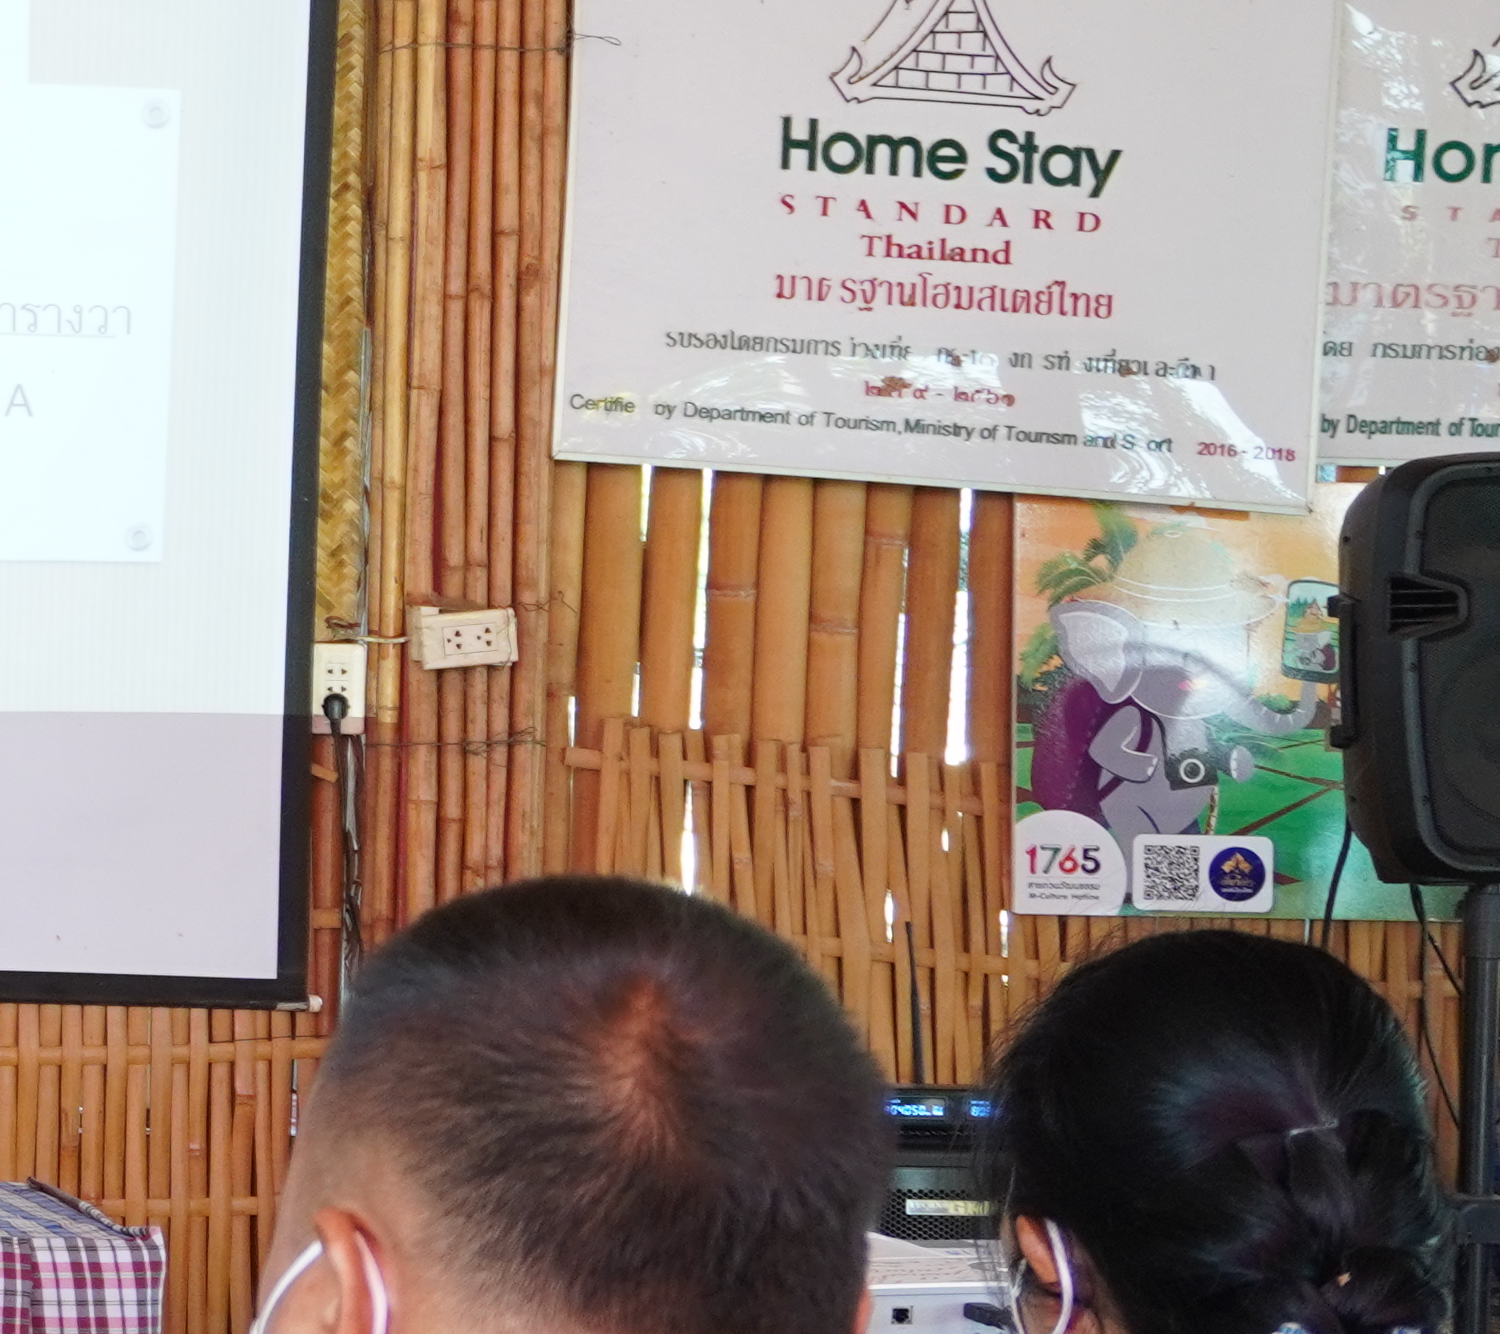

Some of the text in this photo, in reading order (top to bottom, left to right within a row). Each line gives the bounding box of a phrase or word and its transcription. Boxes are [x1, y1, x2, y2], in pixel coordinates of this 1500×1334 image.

[780, 115, 1122, 198] Home Stay
[779, 194, 1102, 234] STANDARD
[861, 234, 1013, 267] Thailand
[570, 393, 635, 414] Certifie
[684, 402, 791, 425] Department
[797, 411, 818, 426] of
[904, 419, 974, 442] Ministry
[980, 425, 998, 440] of
[1121, 435, 1173, 453] Sort
[1197, 441, 1237, 458] 2016
[1253, 445, 1297, 462] 2018
[1346, 415, 1440, 439] Department
[1448, 420, 1464, 436] of
[1025, 844, 1101, 875] 1765
